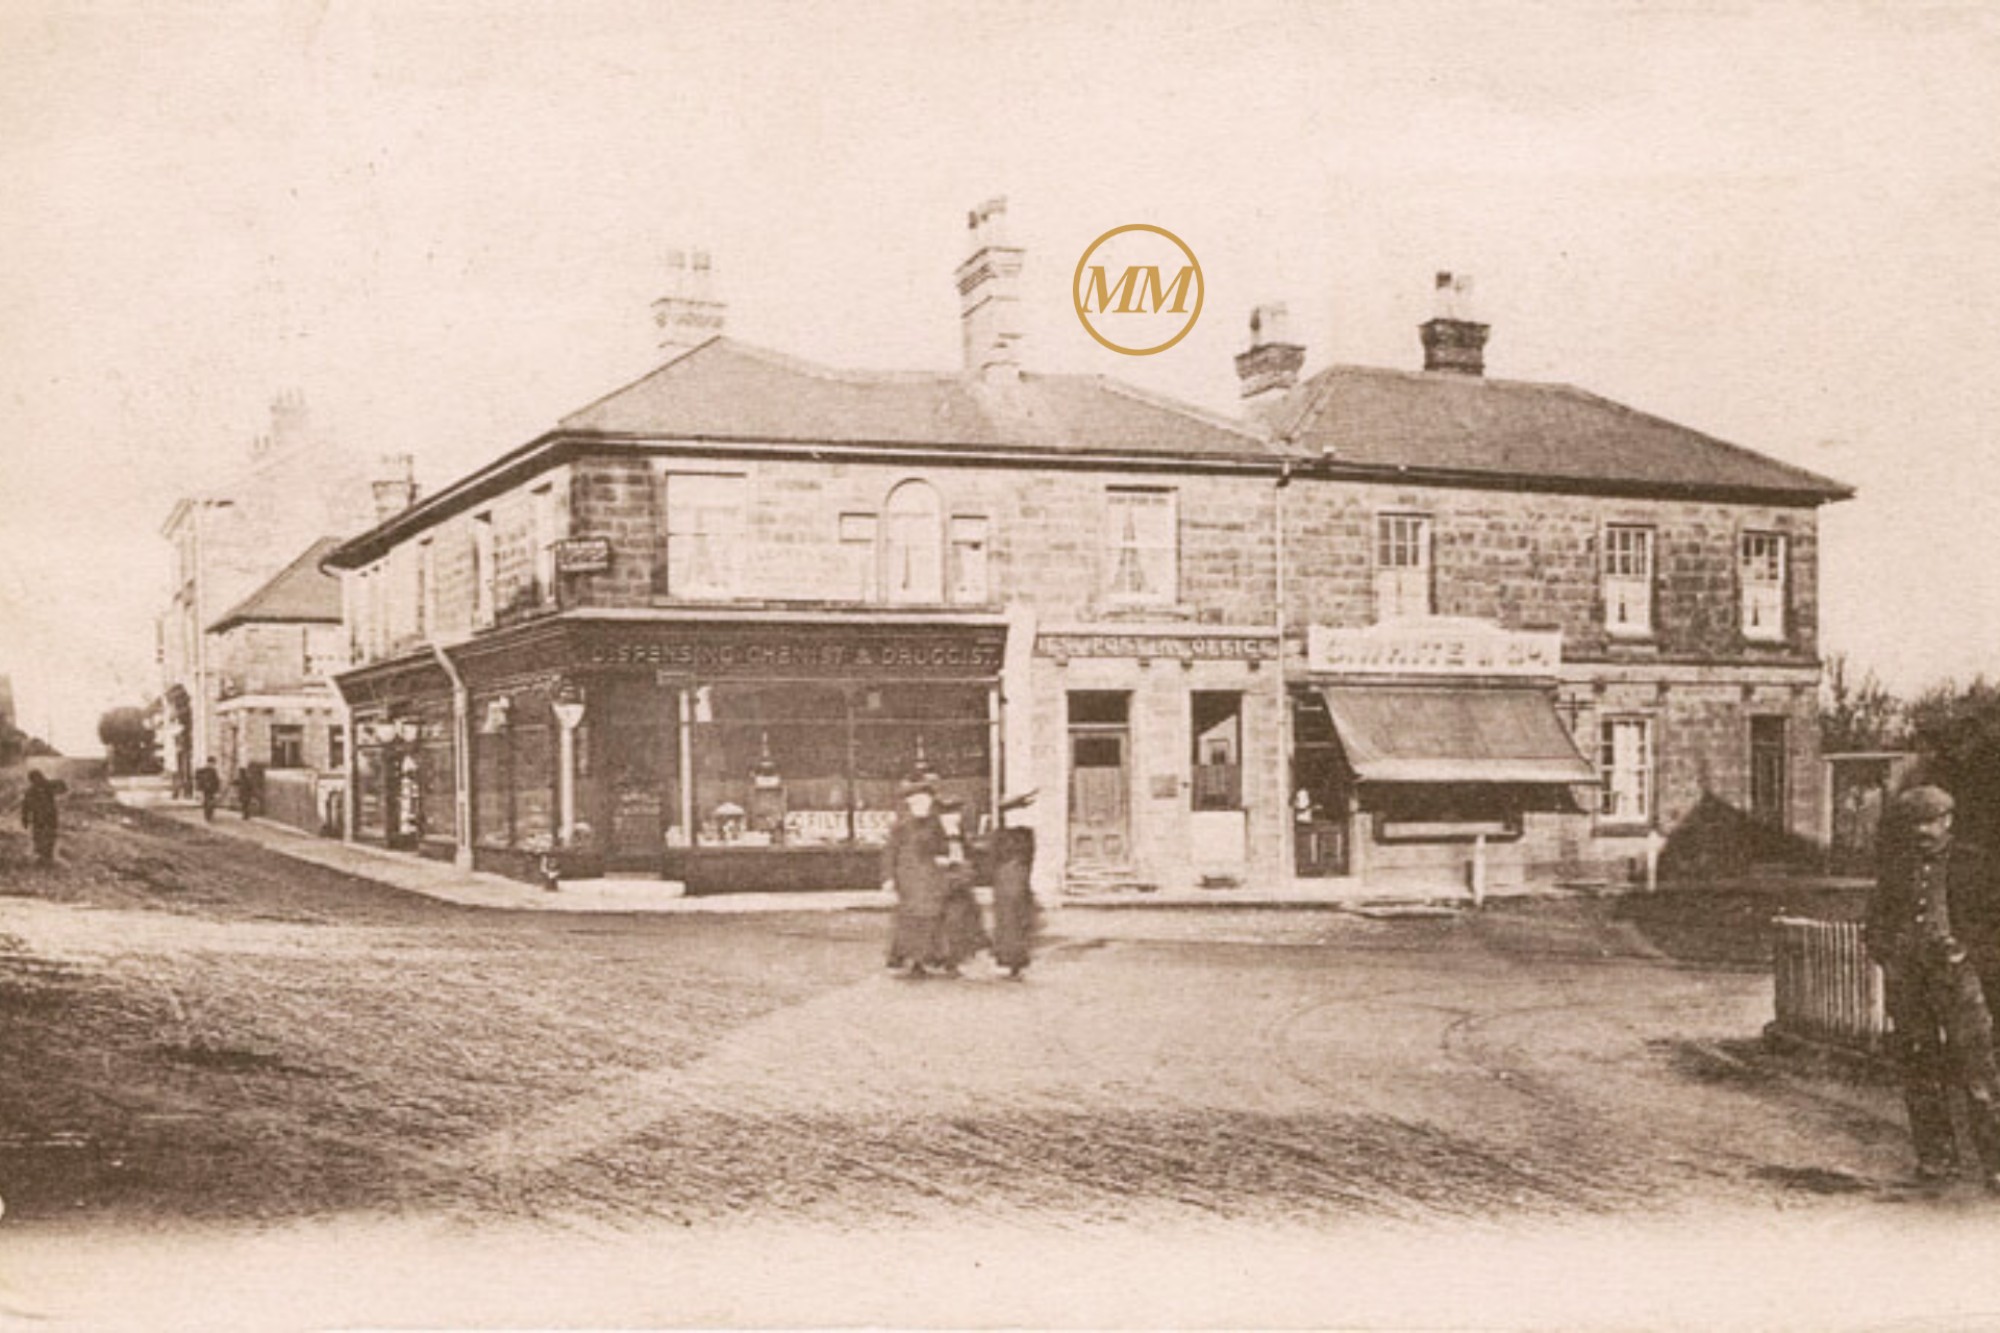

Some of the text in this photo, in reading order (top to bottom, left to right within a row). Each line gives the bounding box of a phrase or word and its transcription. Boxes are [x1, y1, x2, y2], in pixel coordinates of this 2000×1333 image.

[591, 645, 734, 664] DISPENSING
[745, 646, 846, 664] CHEMIST
[857, 648, 875, 664] &
